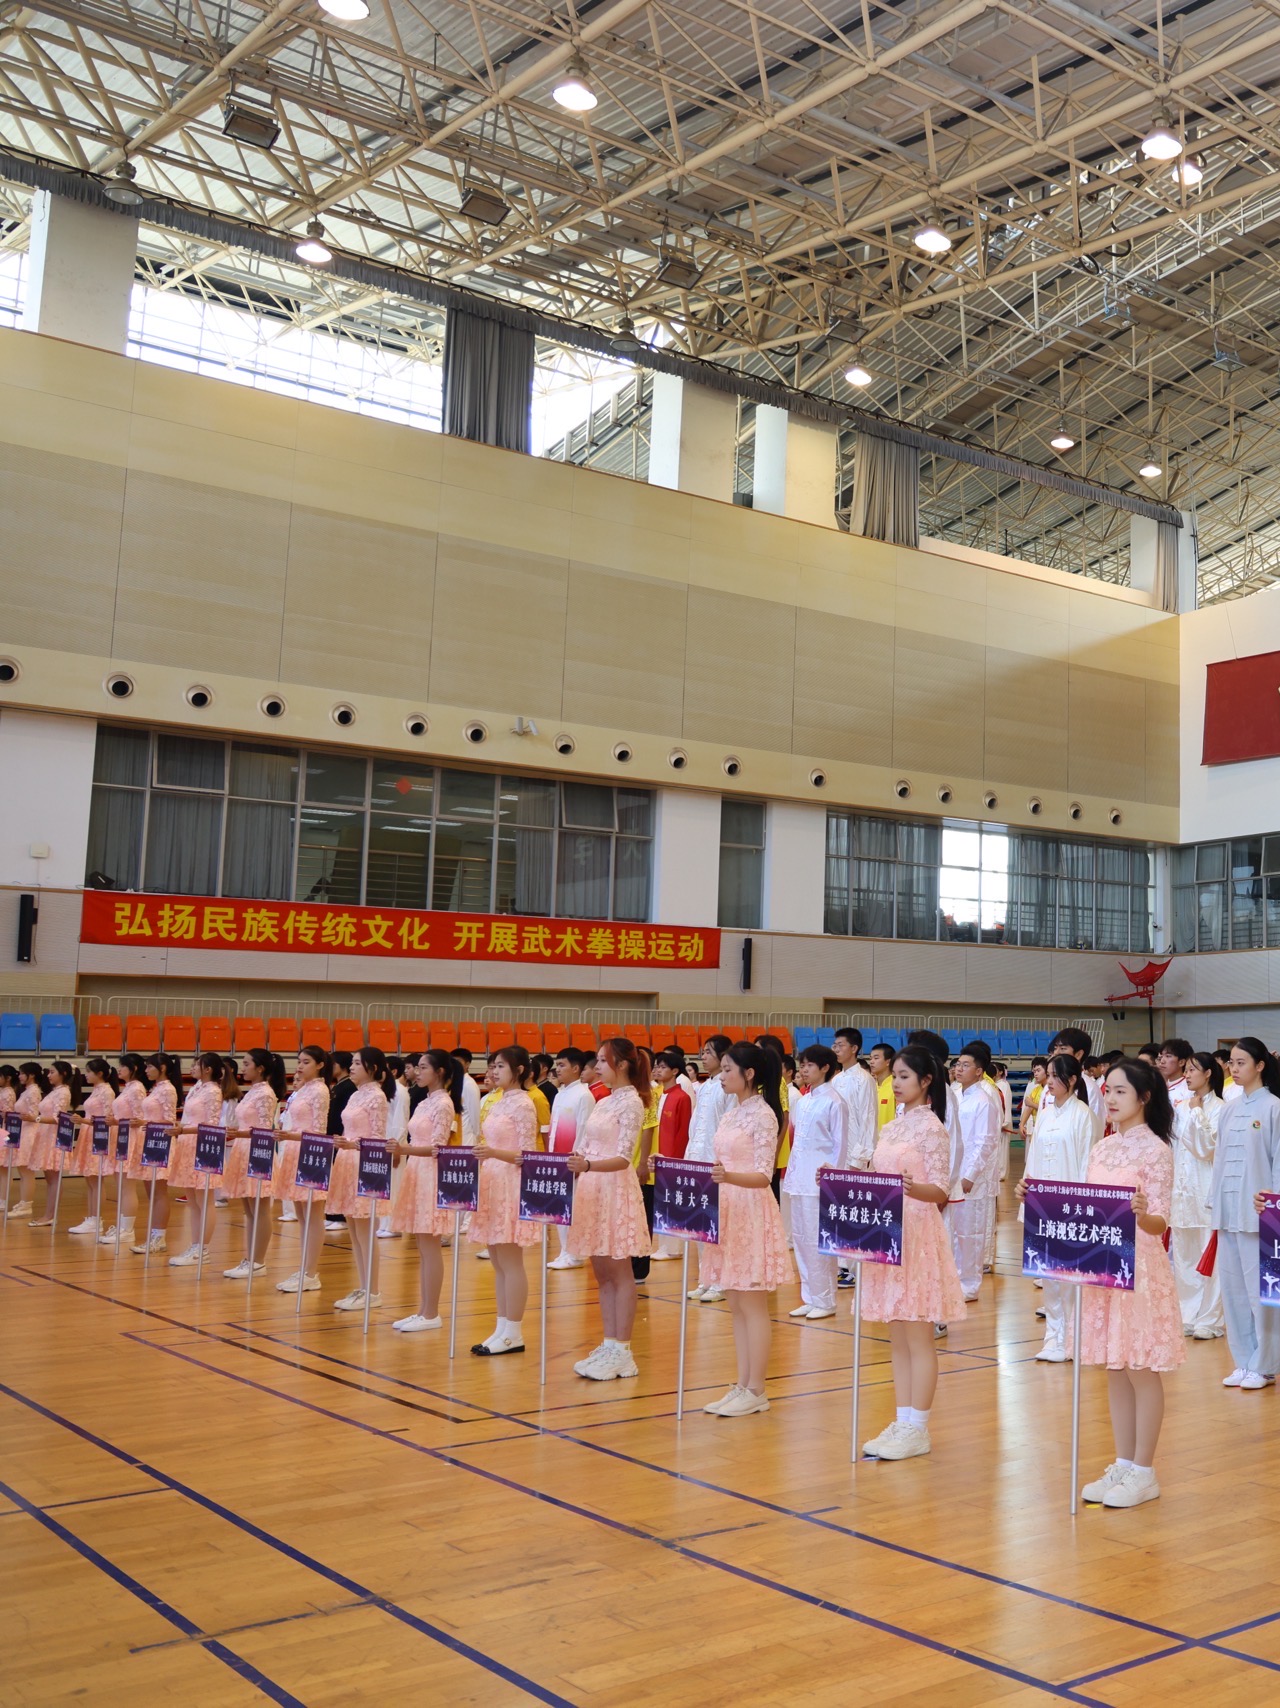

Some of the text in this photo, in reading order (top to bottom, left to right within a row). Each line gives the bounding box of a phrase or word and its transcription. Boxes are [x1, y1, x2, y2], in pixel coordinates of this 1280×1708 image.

[114, 902, 704, 962] 弘扬民族传统文化 开展武术拳操运动
[302, 1154, 327, 1168] 上海大学
[442, 1170, 474, 1184] 上海电力大学
[525, 1178, 567, 1195] 上海政法学院
[848, 1189, 872, 1201] 功夫扇
[663, 1188, 709, 1209] 上海大学
[828, 1203, 893, 1227] 华东政法大学
[1062, 1202, 1095, 1216] 功夫扇
[1035, 1218, 1122, 1246] 上海视觉艺术学院
